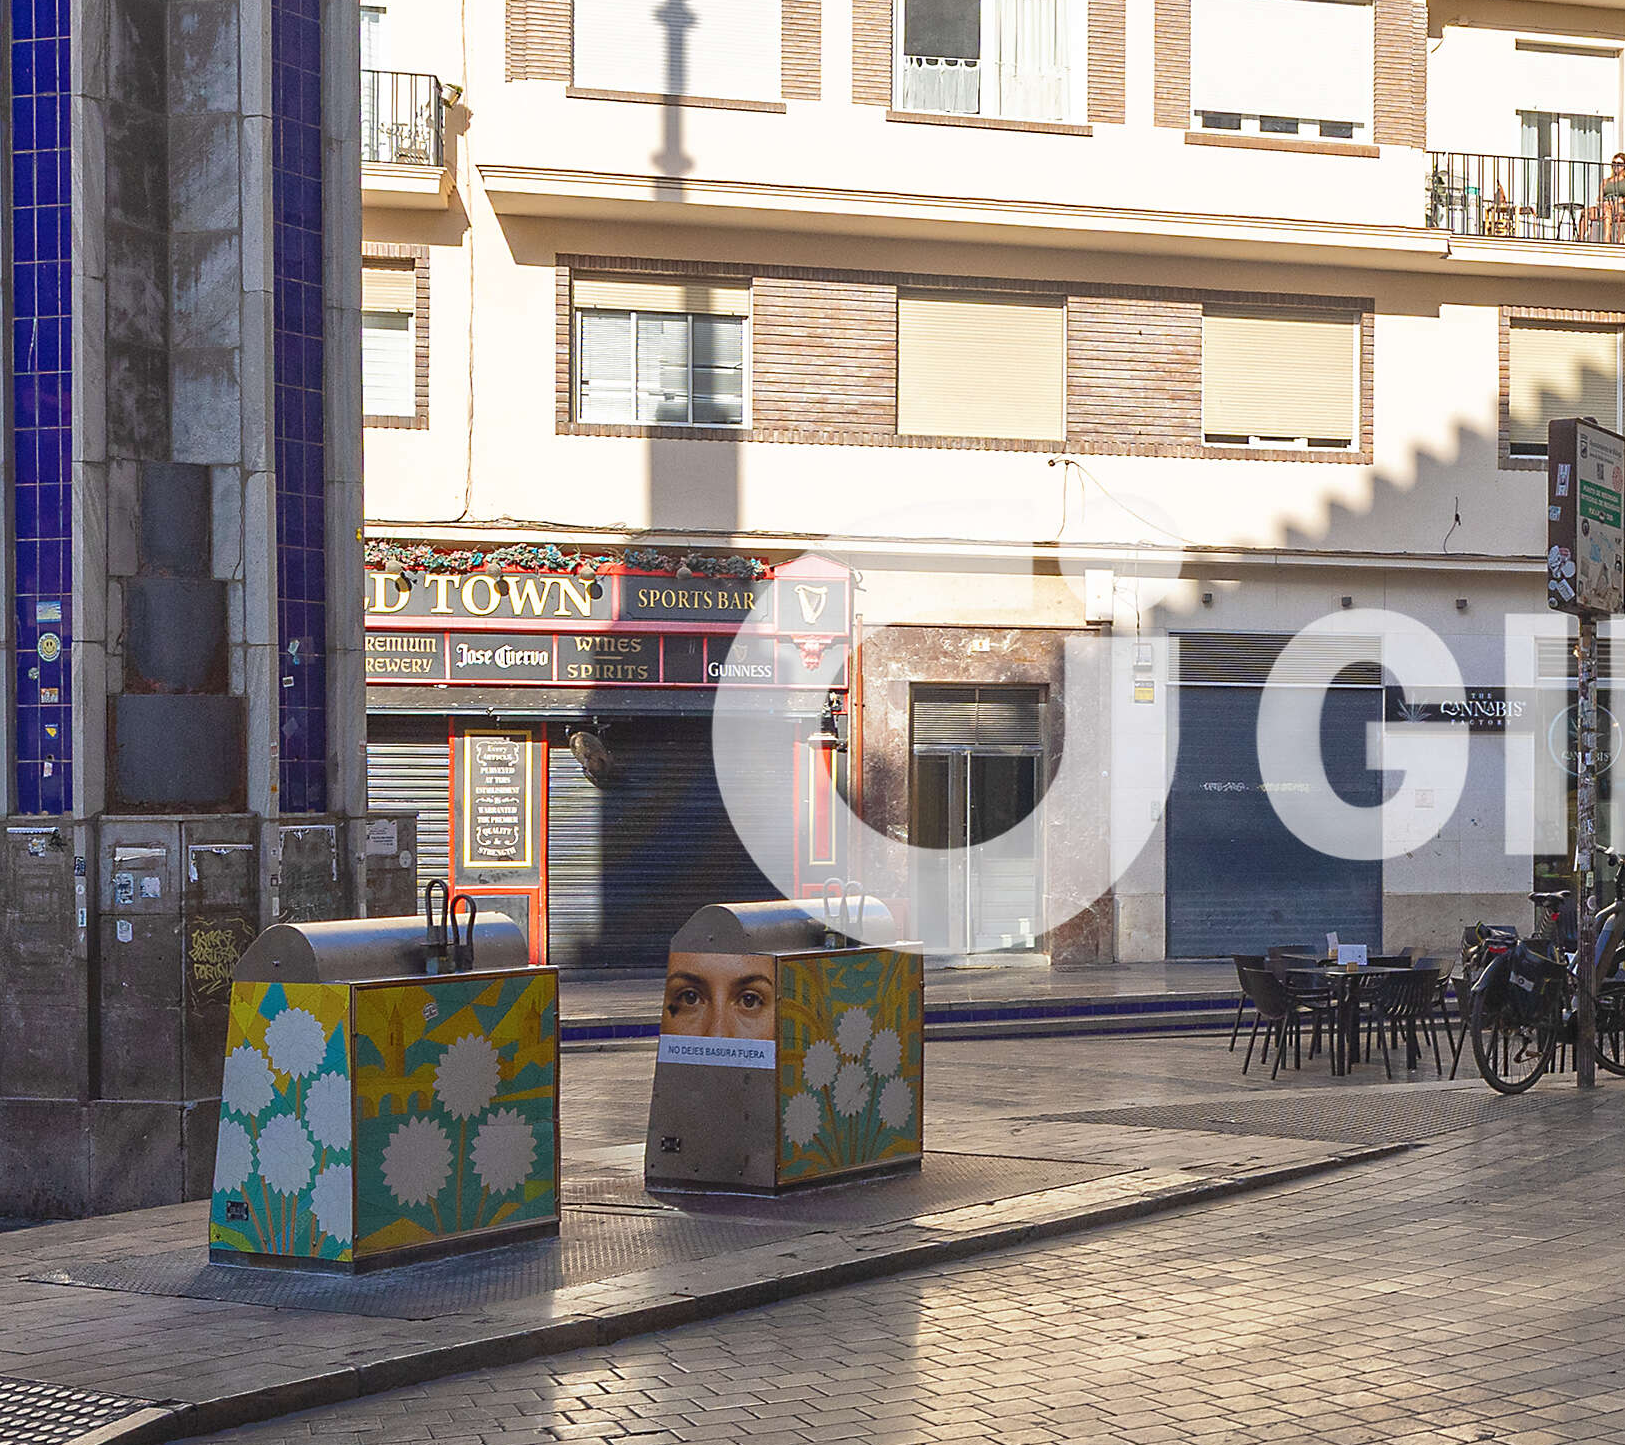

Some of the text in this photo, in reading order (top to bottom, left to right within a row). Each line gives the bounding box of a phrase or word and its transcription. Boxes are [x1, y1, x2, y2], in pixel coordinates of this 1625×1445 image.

[424, 573, 594, 618] TOWN
[638, 588, 756, 611] SPORTS BAR
[365, 636, 437, 653] REMIUM
[575, 637, 642, 652] WINES
[456, 643, 548, 668] Jose Cuervo
[366, 658, 433, 673] REWERY
[567, 663, 648, 680] SPIRITS
[708, 662, 772, 678] GUINNESS
[668, 1045, 765, 1059] NO DEJES BASURA FUERA
